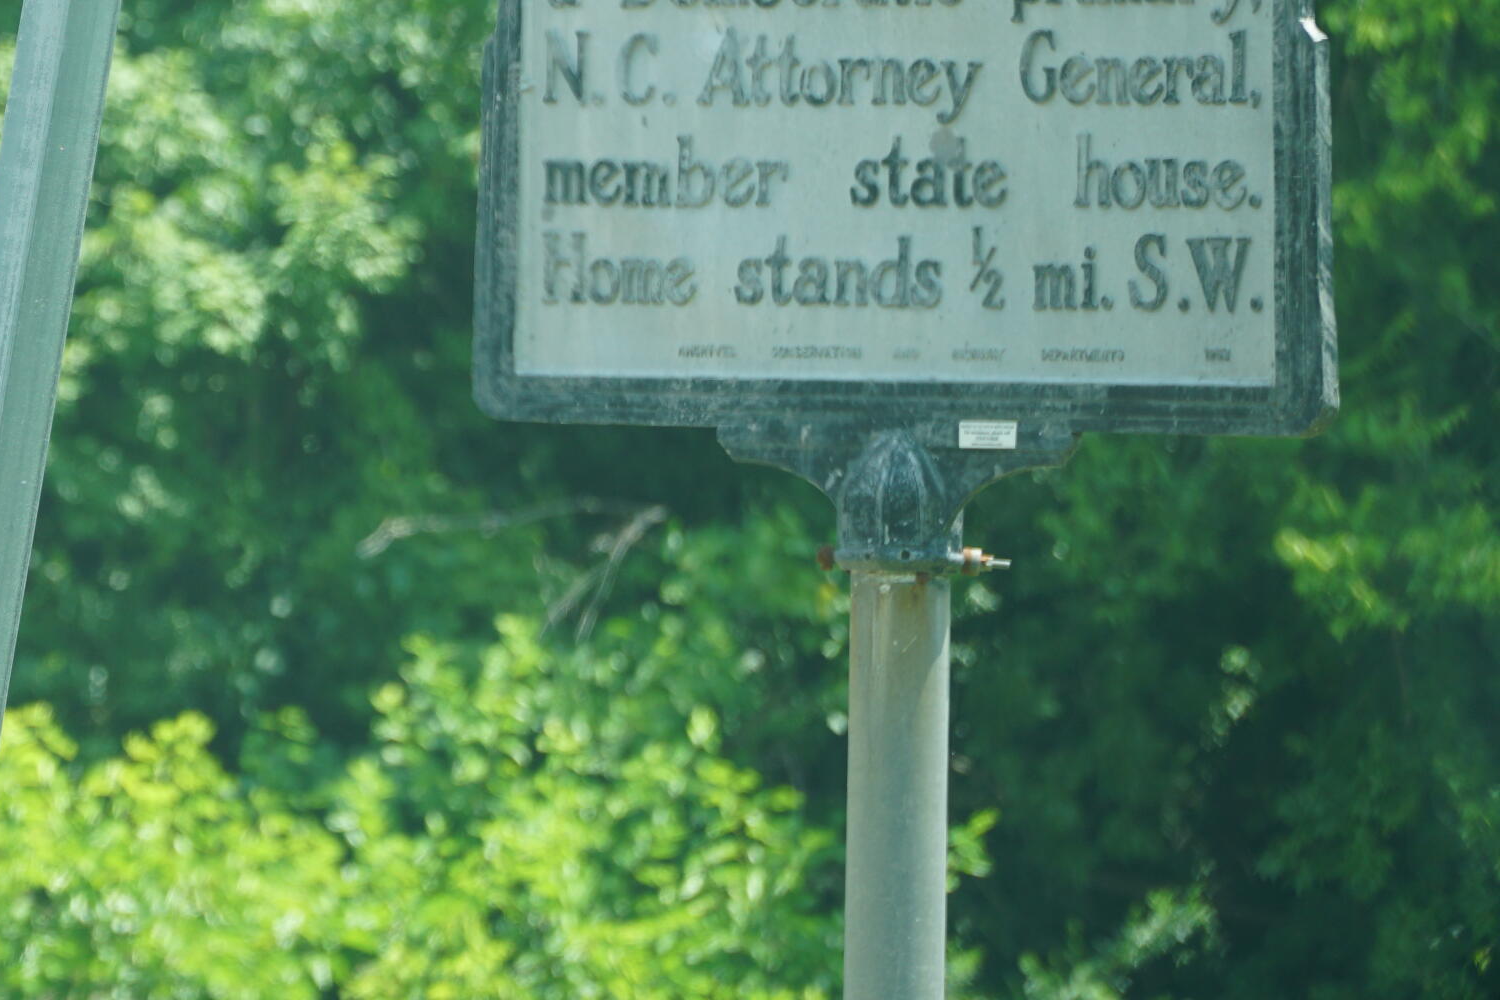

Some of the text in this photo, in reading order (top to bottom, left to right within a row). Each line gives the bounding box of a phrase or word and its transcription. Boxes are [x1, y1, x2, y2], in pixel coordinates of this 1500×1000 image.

[696, 26, 982, 125] Attorney
[1018, 29, 1262, 110] General,
[542, 133, 1263, 211] member state house.
[542, 231, 698, 307] Home
[734, 234, 943, 310] stands
[1032, 246, 1114, 312] mi.
